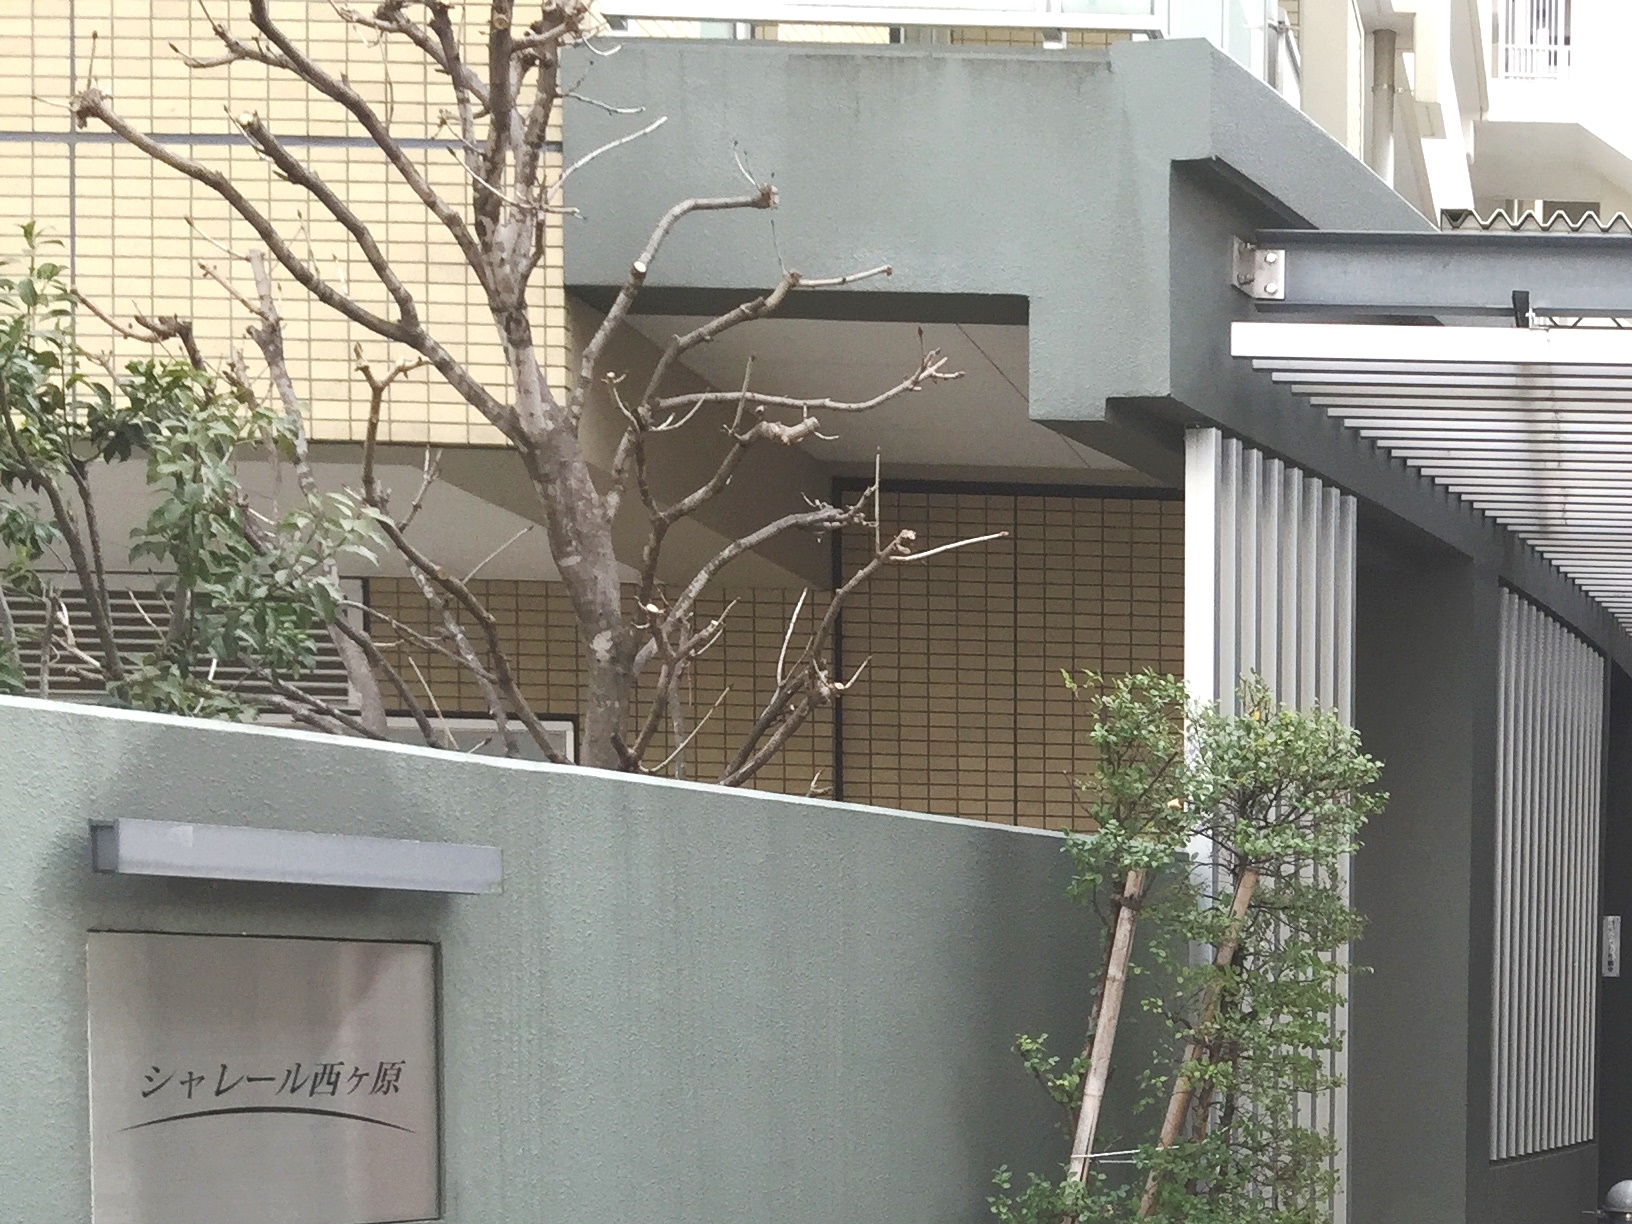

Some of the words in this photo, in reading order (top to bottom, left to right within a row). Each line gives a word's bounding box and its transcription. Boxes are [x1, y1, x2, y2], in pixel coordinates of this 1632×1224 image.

[141, 1060, 406, 1099] シャレール西ヶ原
